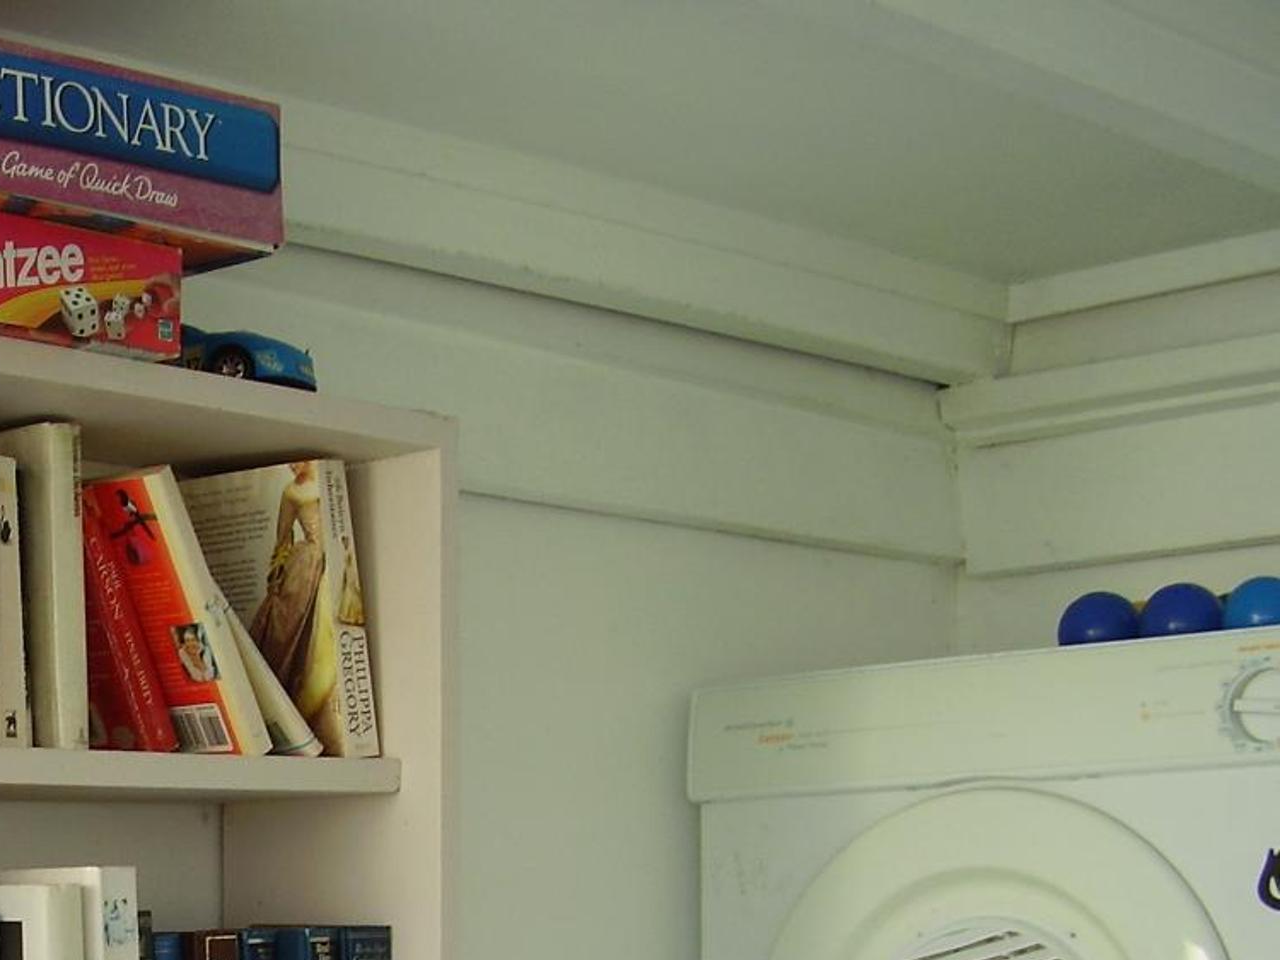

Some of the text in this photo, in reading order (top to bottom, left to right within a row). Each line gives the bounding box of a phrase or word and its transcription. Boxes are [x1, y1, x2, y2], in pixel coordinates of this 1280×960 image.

[1, 151, 54, 182] Game
[57, 162, 80, 188] of
[79, 163, 136, 200] Quick
[133, 176, 179, 208] Draw
[85, 536, 125, 621] CARSON
[105, 560, 123, 590] PAUL
[336, 629, 362, 737] GREGORY
[349, 634, 376, 736] PHILIPPA
